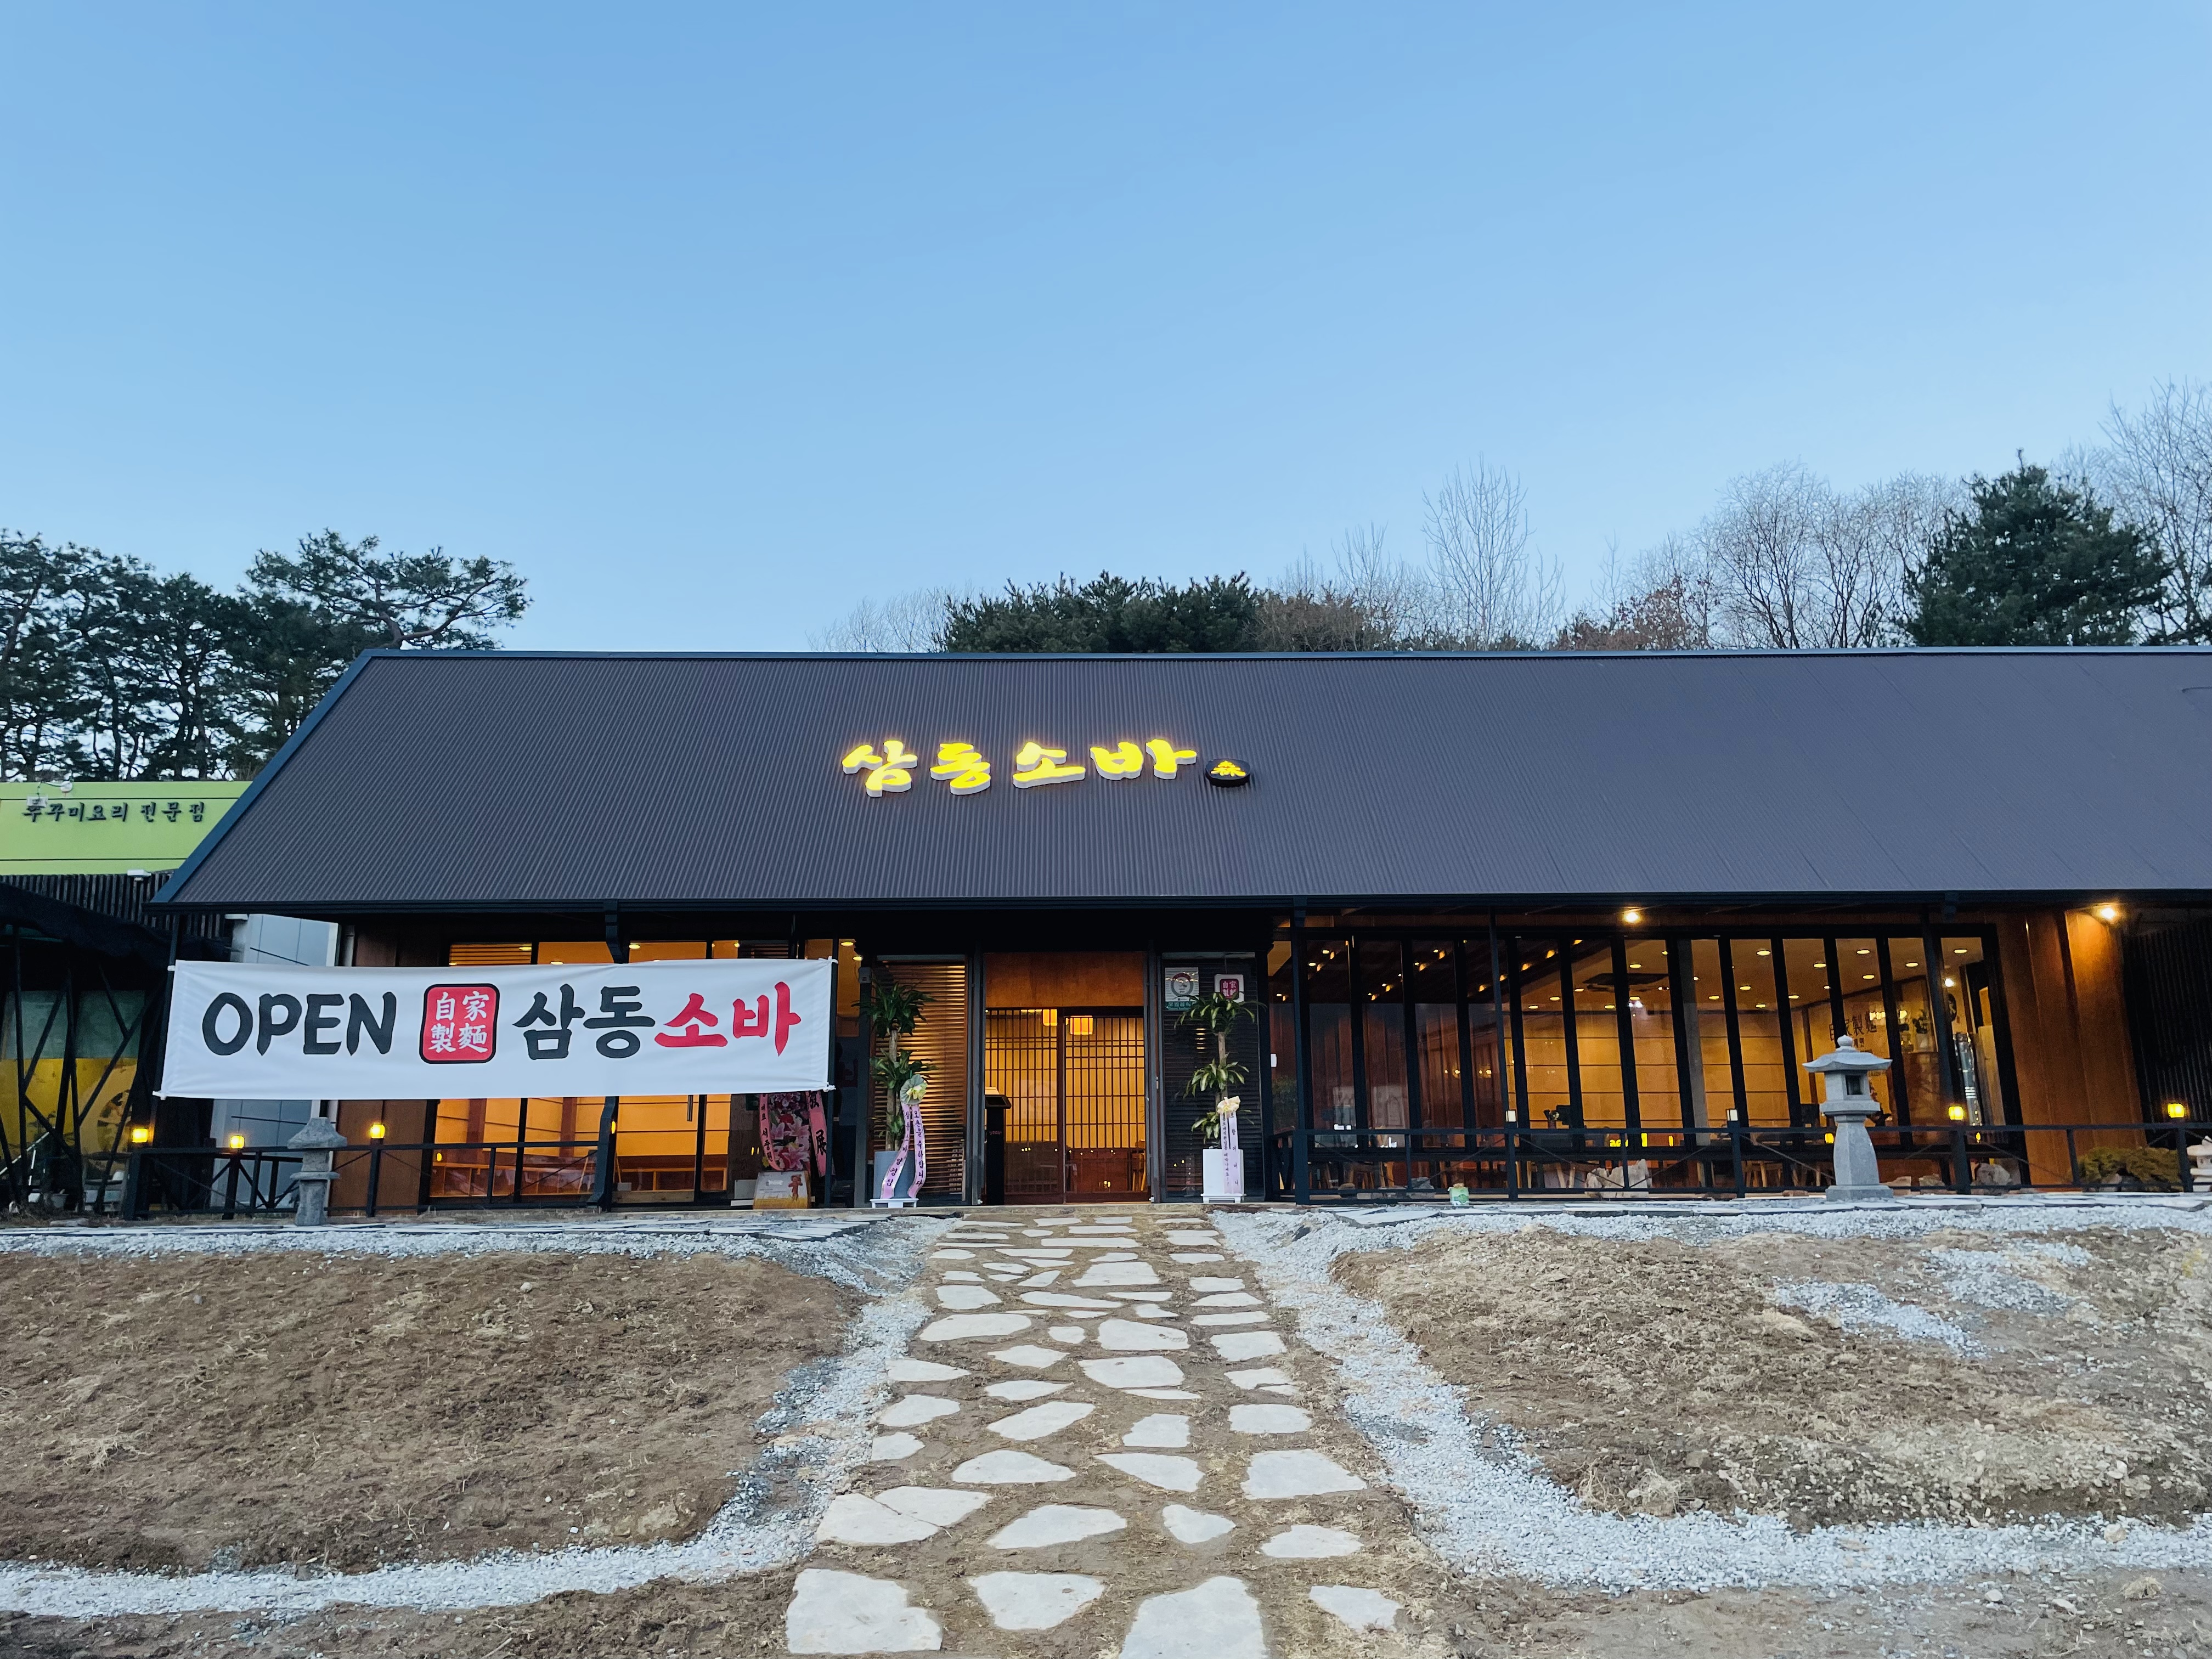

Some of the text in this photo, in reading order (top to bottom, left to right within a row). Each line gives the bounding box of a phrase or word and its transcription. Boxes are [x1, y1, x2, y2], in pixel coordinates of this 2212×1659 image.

[842, 739, 1197, 798] 삼동소바
[140, 801, 205, 822] 전문점
[202, 991, 397, 1057] OPEN
[512, 981, 802, 1060] 삼동소바
[913, 1110, 924, 1187] 오픈을 축하합니다
